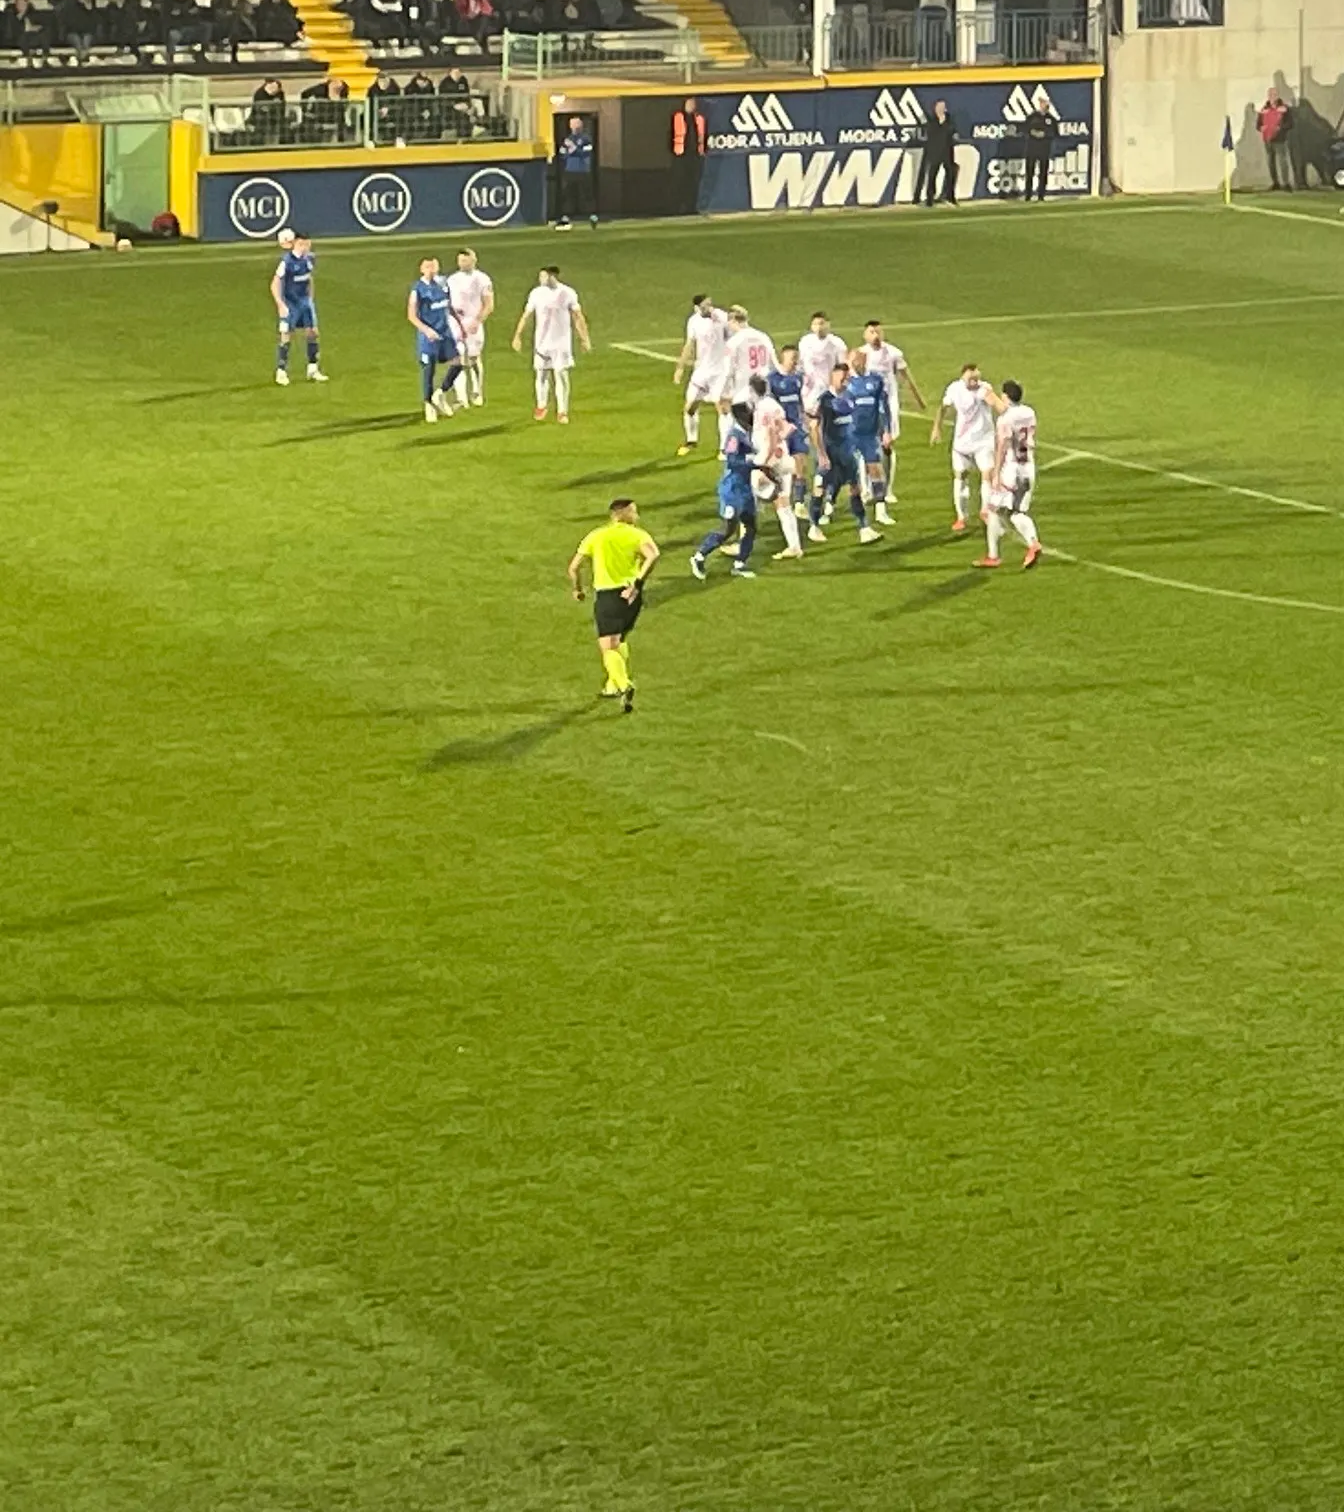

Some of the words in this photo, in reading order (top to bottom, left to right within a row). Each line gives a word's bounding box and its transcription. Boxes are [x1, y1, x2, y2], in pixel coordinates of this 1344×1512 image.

[764, 130, 825, 148] STIJENA
[838, 128, 898, 144] MODRA
[972, 123, 1018, 139] MODR
[359, 190, 403, 214] MCI
[470, 185, 512, 208] MCI
[237, 196, 282, 219] MCI
